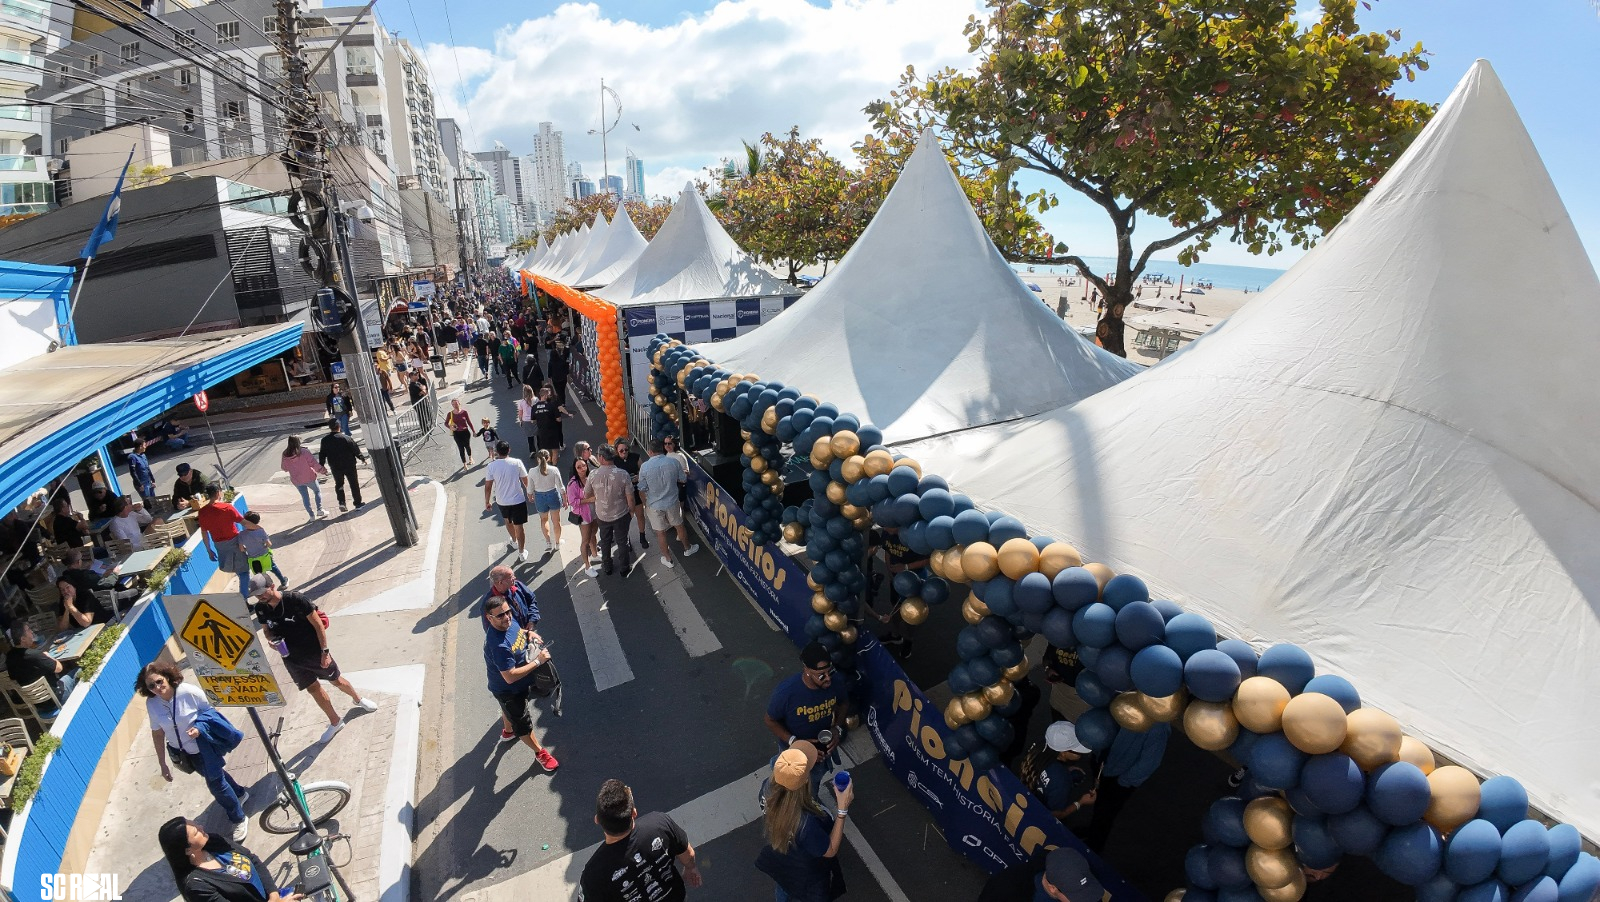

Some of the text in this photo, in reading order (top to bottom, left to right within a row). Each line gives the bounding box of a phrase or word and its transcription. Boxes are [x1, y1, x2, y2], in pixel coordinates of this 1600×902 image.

[706, 481, 786, 590] Pioneiros
[203, 675, 271, 684] TRAVESSIA
[212, 685, 268, 693] EEVADA
[227, 695, 236, 703] A
[238, 695, 262, 703] 50m
[905, 735, 929, 766] QUEM
[931, 763, 953, 786] TEM
[1004, 834, 1023, 861] FAZ
